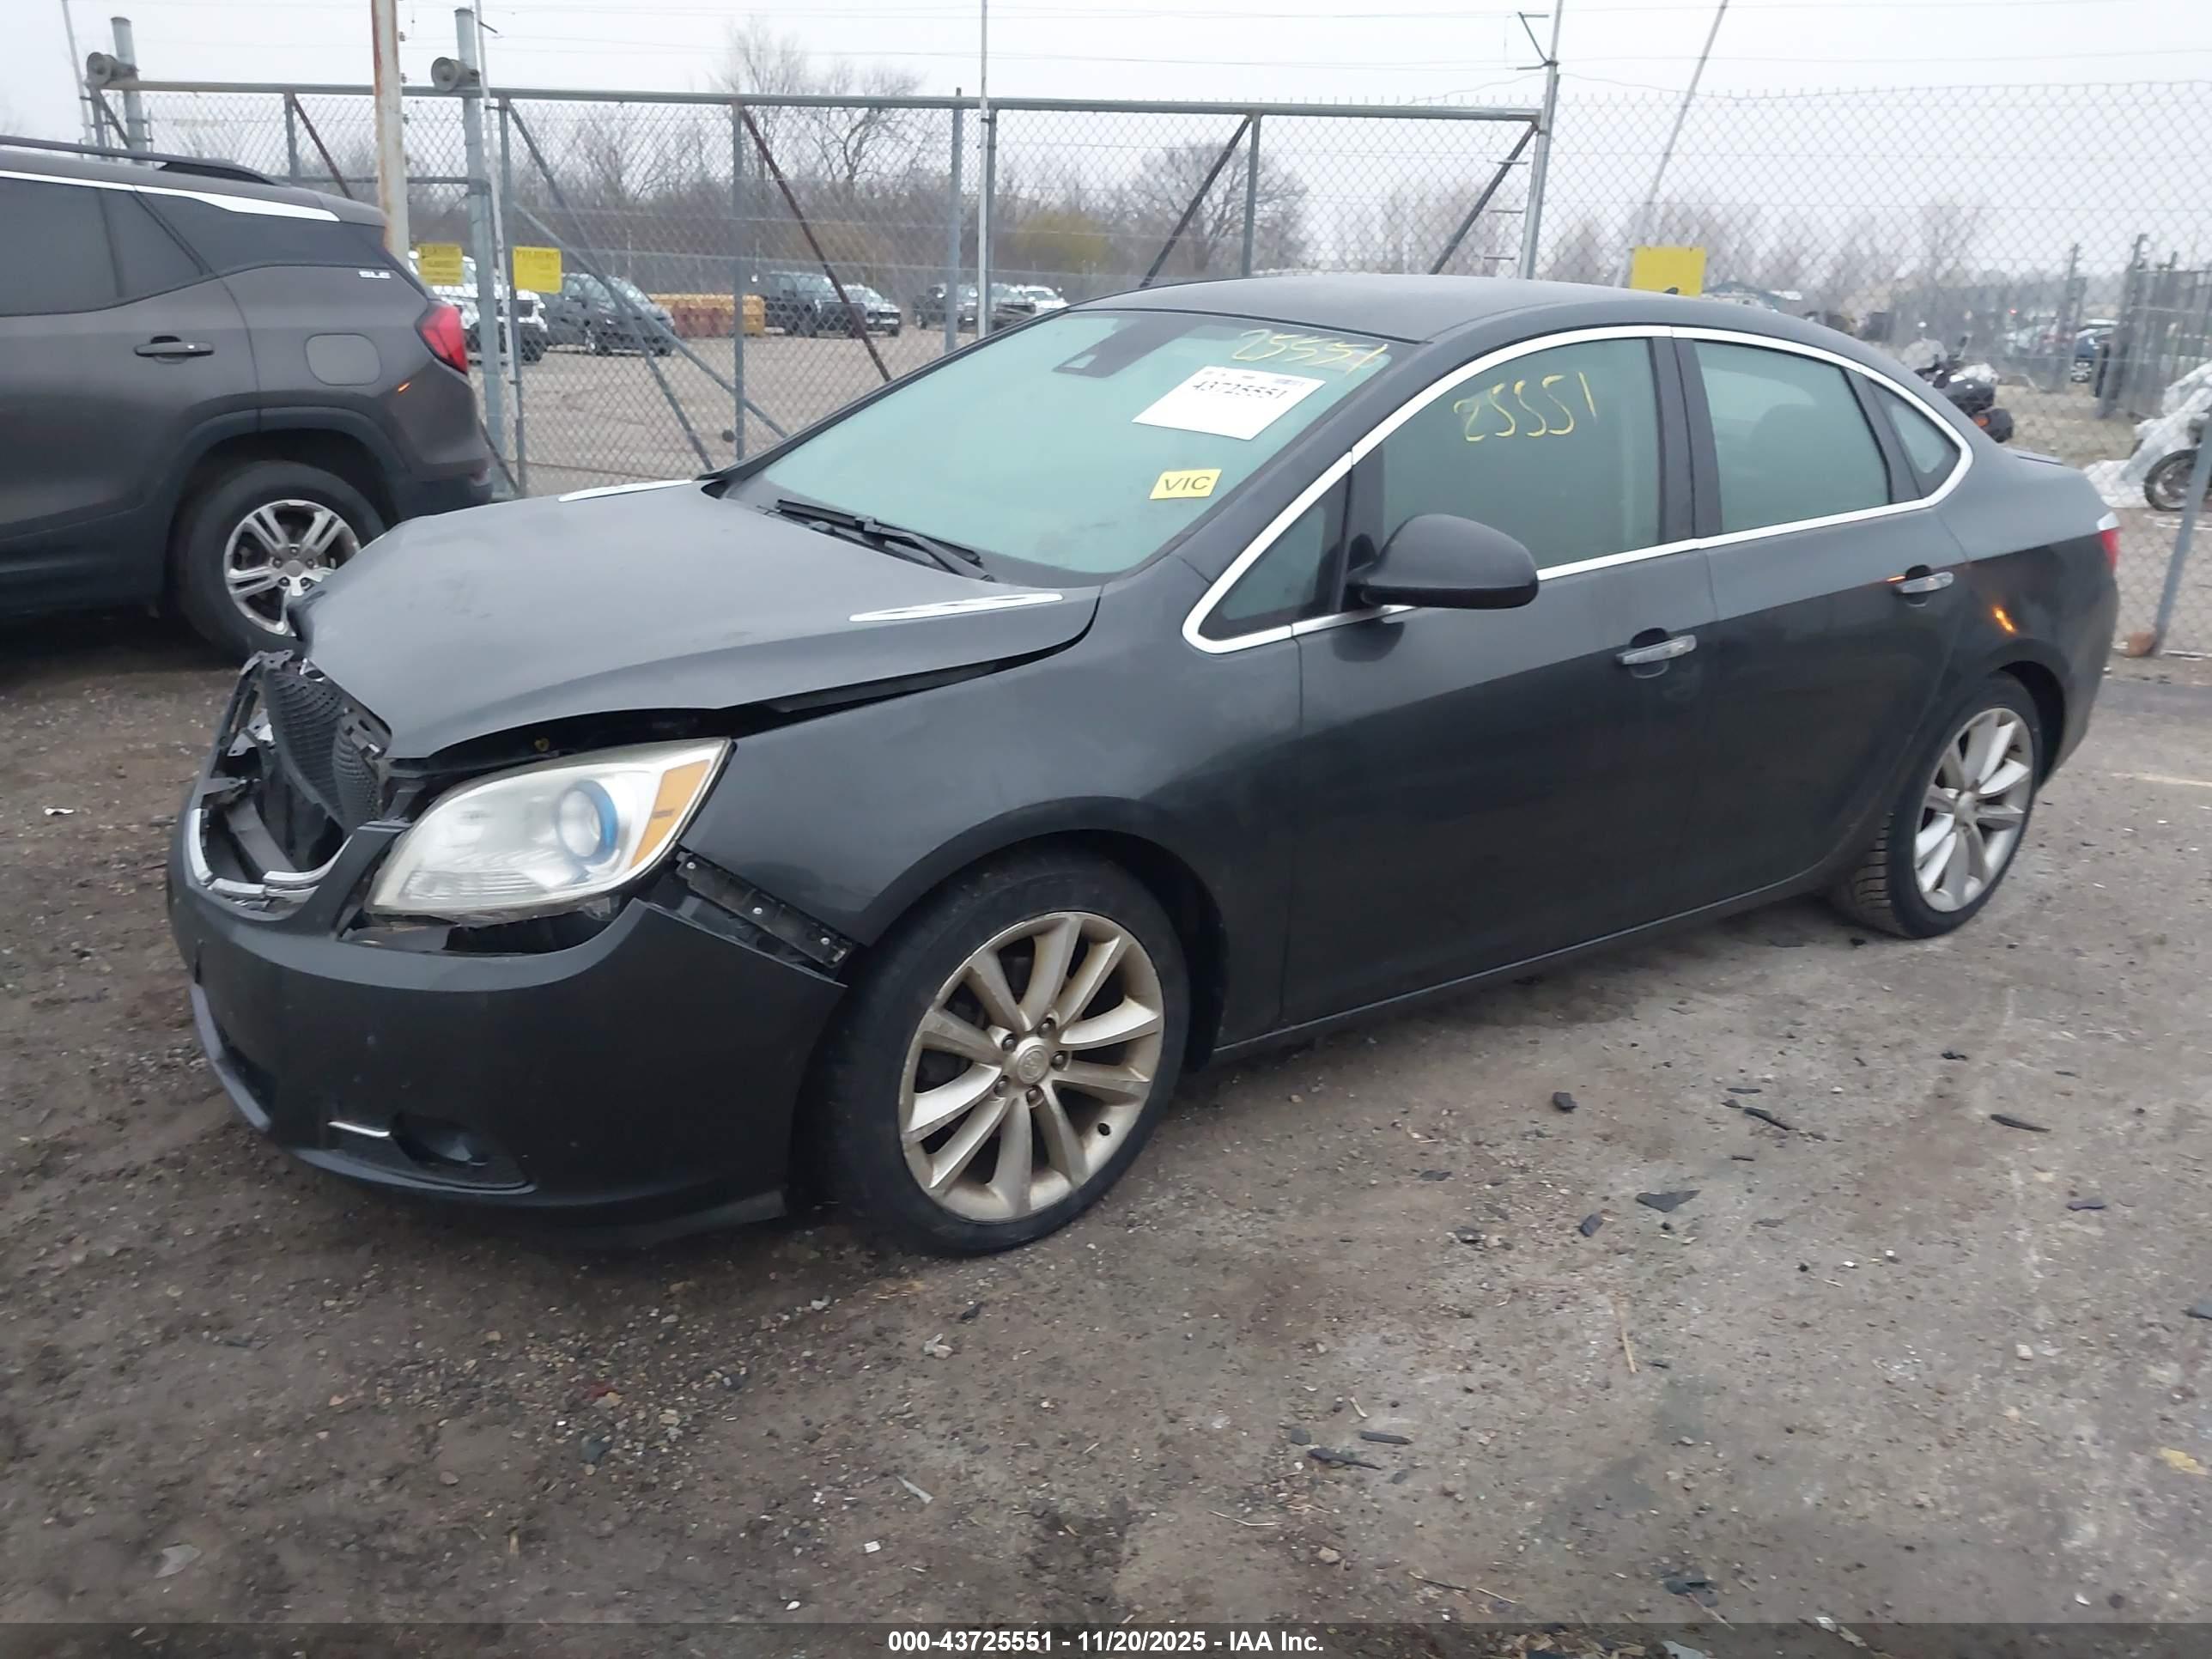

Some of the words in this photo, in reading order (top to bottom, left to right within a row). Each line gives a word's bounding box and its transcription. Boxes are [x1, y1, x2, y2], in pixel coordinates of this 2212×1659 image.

[1231, 328, 1389, 375] 25551
[1453, 371, 1598, 441] 25551
[1164, 476, 1212, 492] VIC
